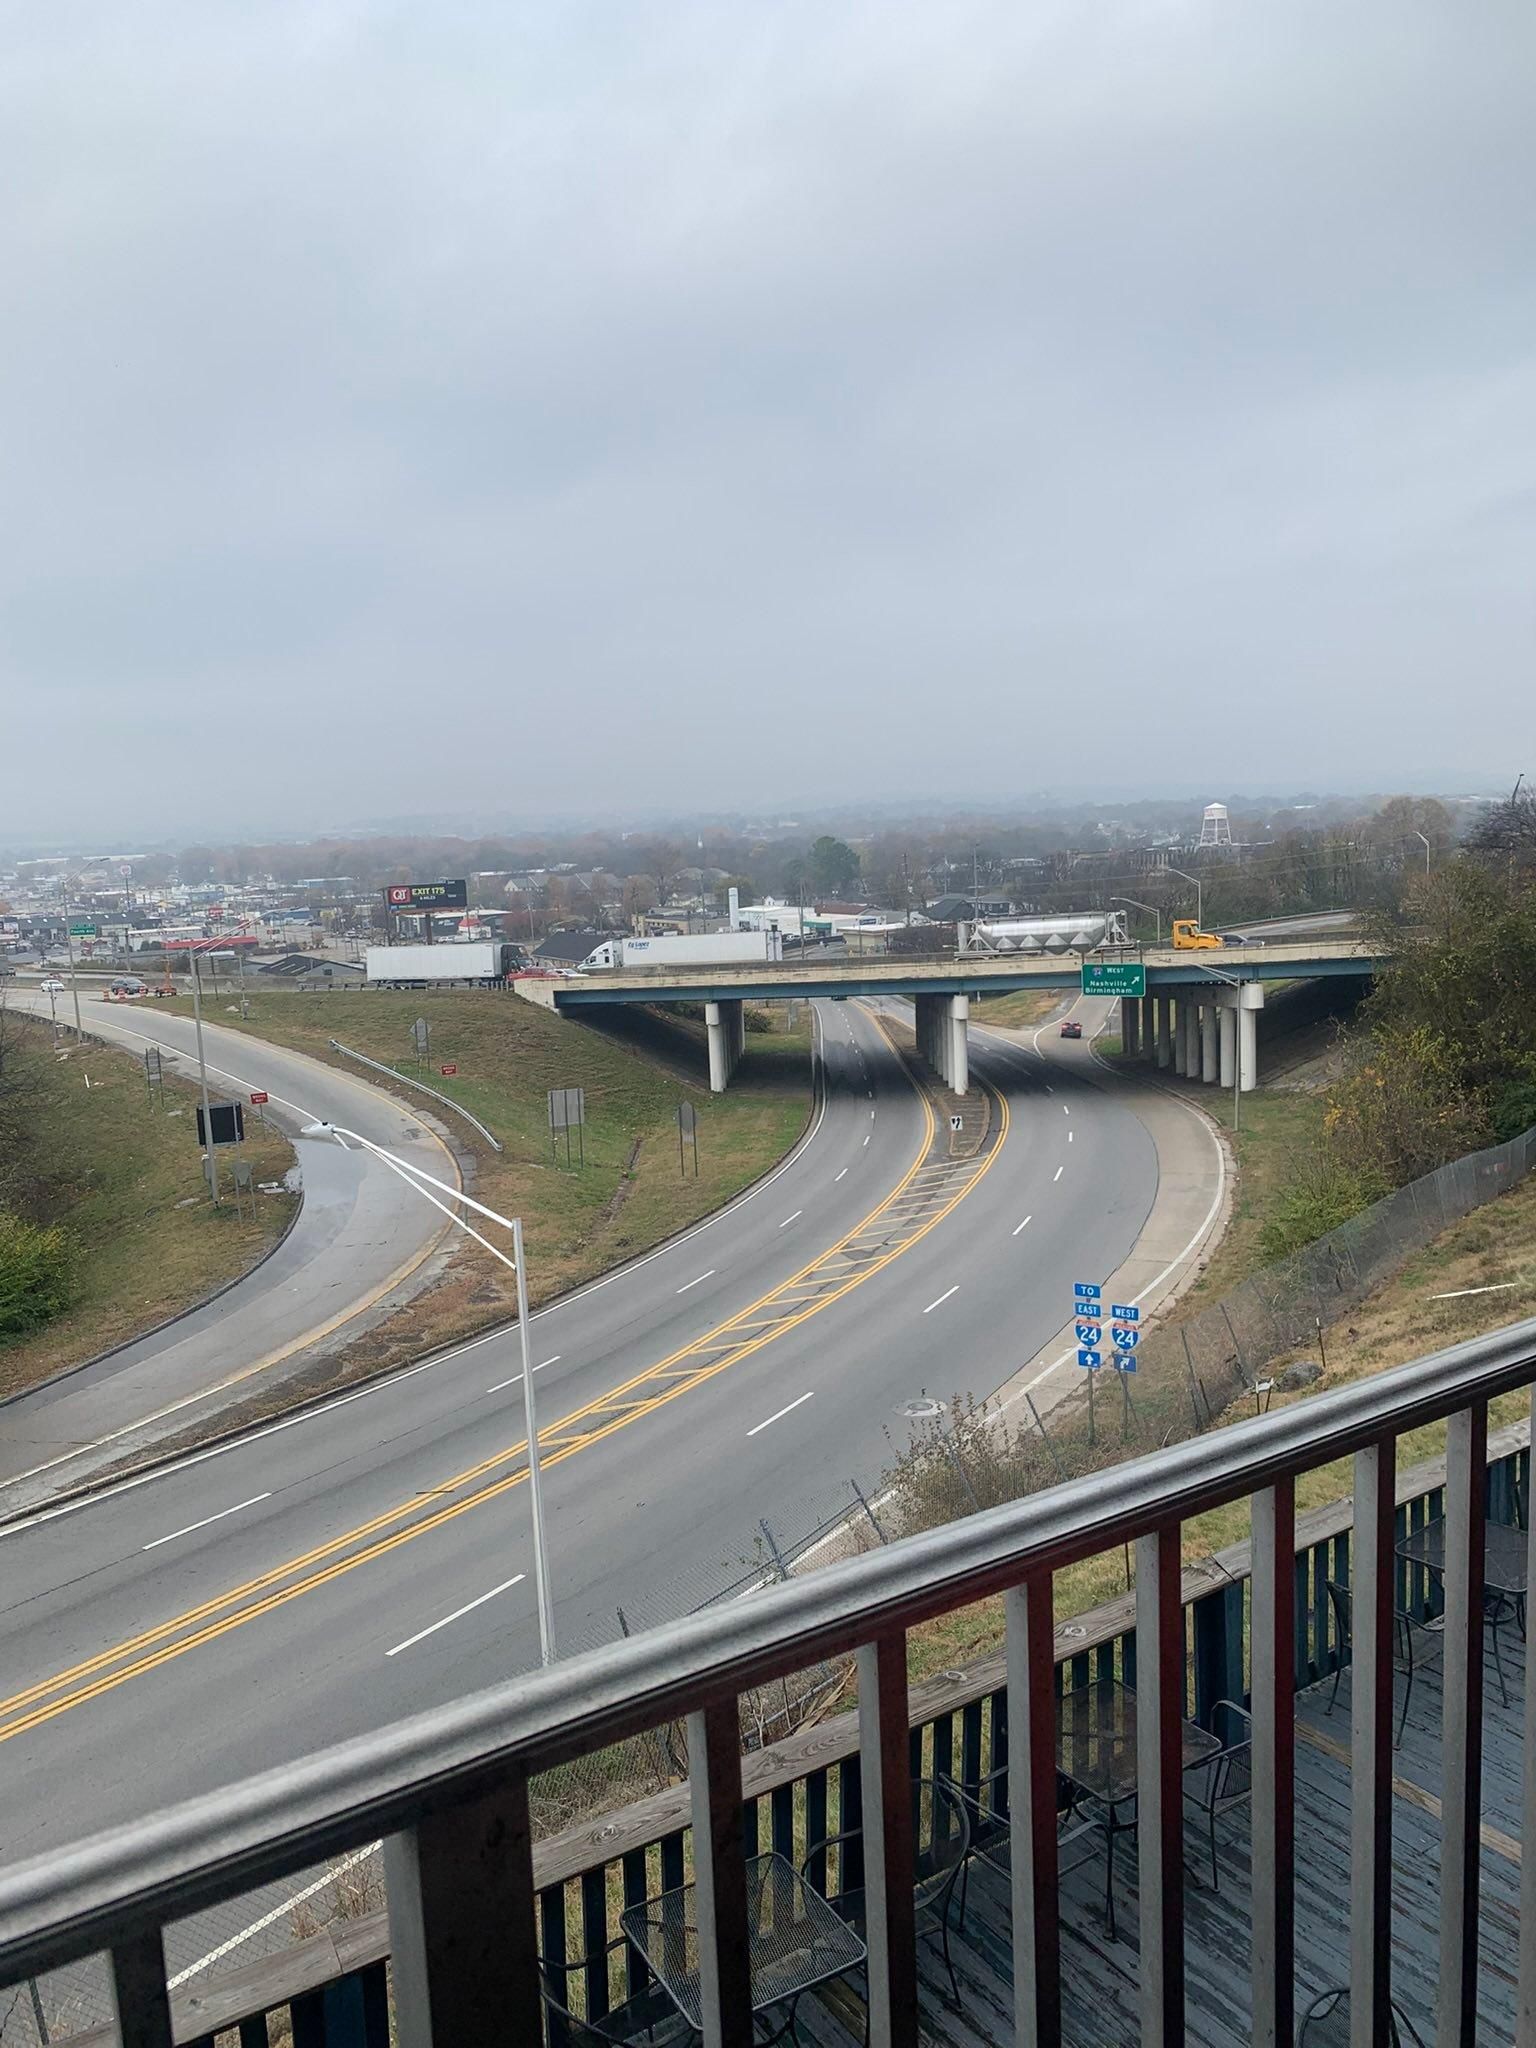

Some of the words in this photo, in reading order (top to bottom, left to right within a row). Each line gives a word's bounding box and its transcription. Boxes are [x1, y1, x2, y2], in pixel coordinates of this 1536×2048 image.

[393, 889, 407, 900] QT
[412, 888, 431, 896] EXIT
[431, 887, 445, 895] 175
[1085, 987, 1133, 995] Birmingham
[1080, 1286, 1095, 1296] TO
[1078, 1304, 1097, 1315] EAST
[1115, 1307, 1135, 1318] WEST
[1080, 1326, 1098, 1343] 24
[1116, 1329, 1135, 1347] 24
